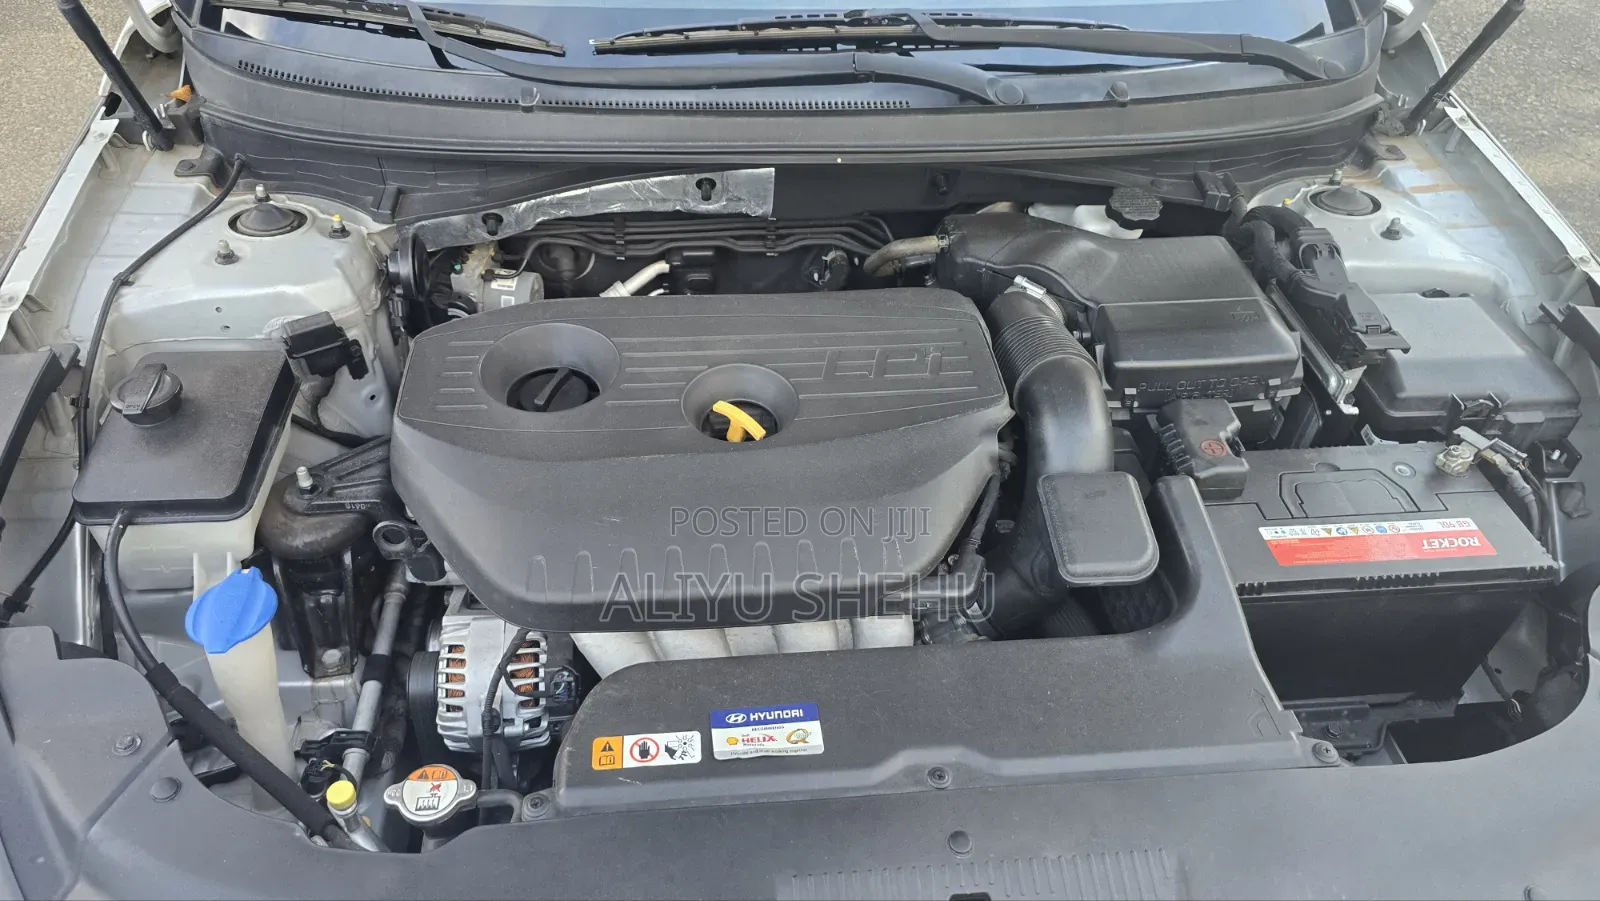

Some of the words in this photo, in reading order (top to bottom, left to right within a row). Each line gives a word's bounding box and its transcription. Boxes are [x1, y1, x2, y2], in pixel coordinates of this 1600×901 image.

[1137, 382, 1173, 392] PULL
[1176, 379, 1206, 390] OUT
[1209, 377, 1227, 388] TO
[1421, 536, 1482, 549] ROCKET
[749, 708, 804, 722] HYUNDAI
[741, 734, 777, 744] HELIX
